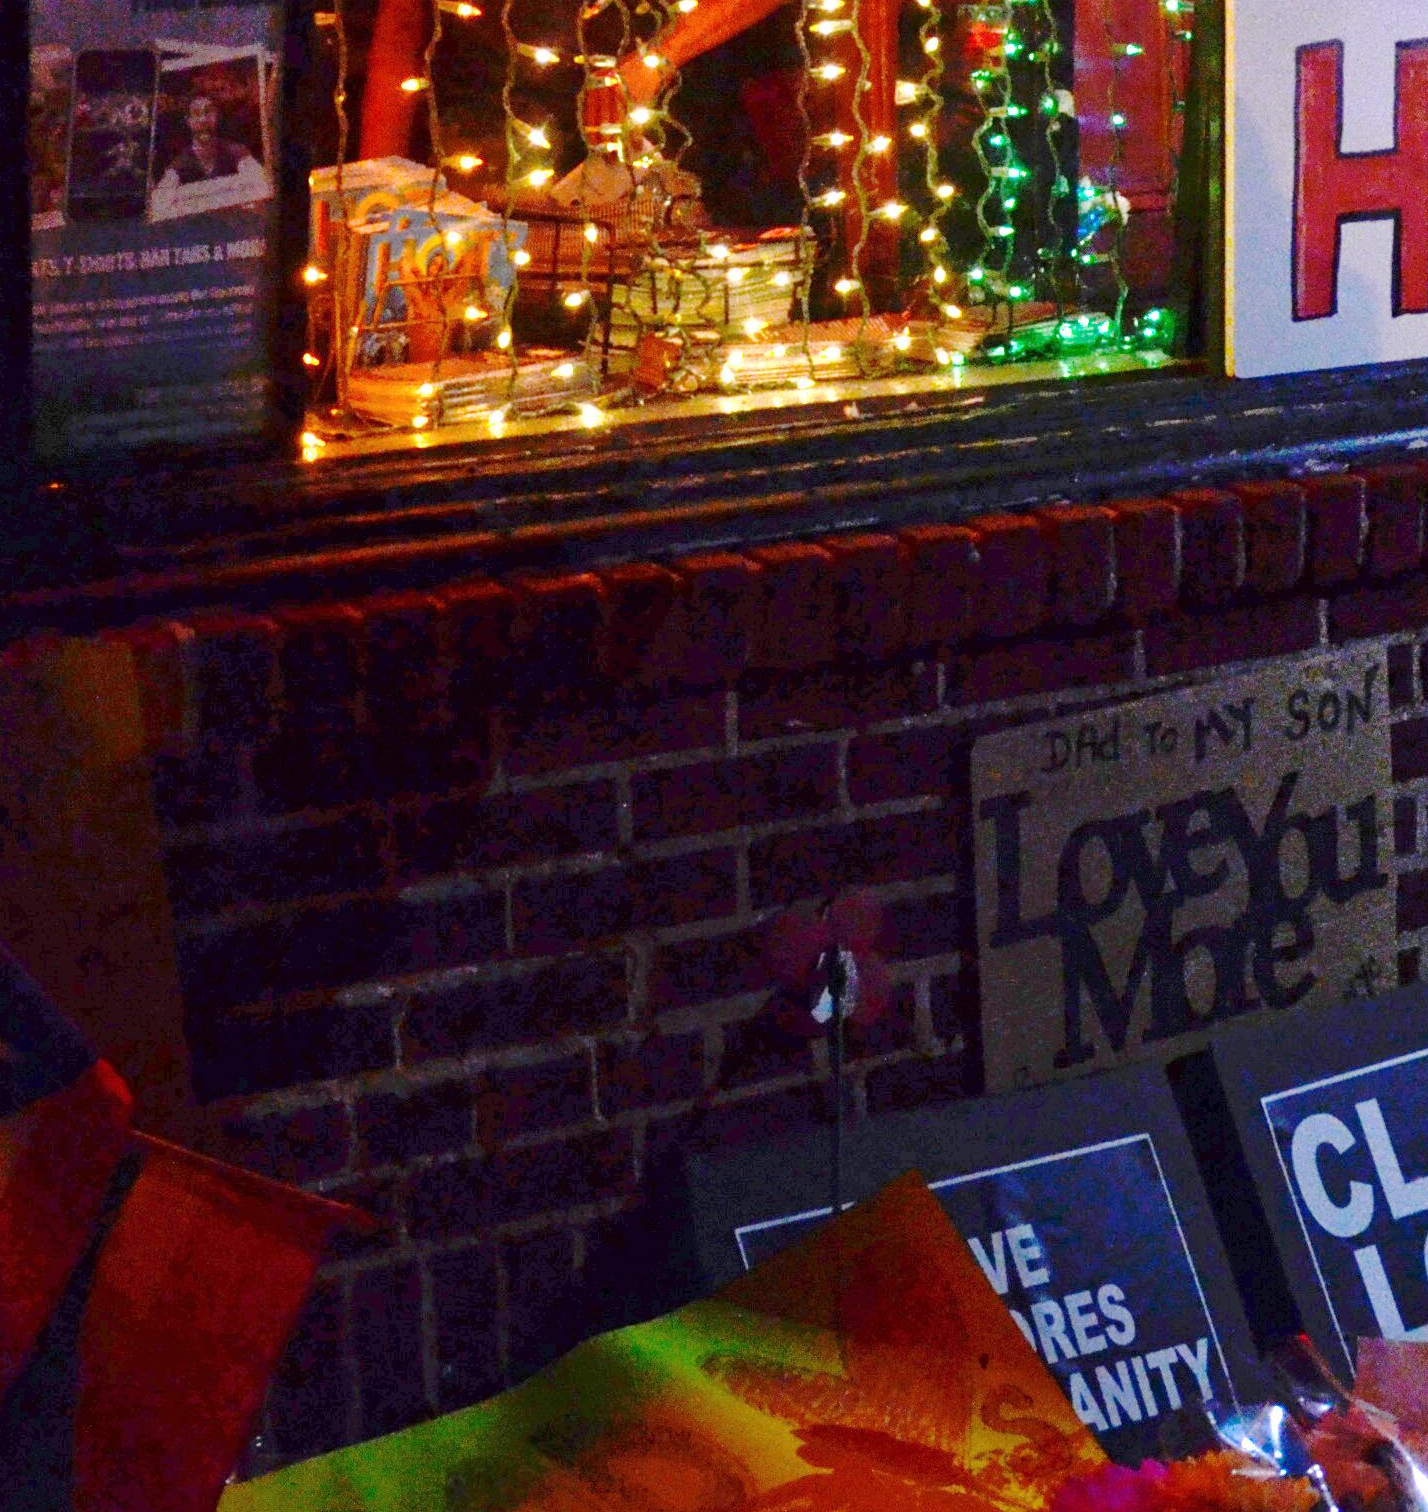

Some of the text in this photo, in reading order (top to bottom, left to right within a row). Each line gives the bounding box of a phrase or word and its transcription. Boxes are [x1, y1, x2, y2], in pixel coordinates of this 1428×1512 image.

[1193, 698, 1255, 764] MY
[1284, 664, 1378, 742] SON
[1053, 912, 1316, 1068] More
[967, 1223, 1052, 1296] VE
[1070, 1337, 1216, 1433] ANITY
